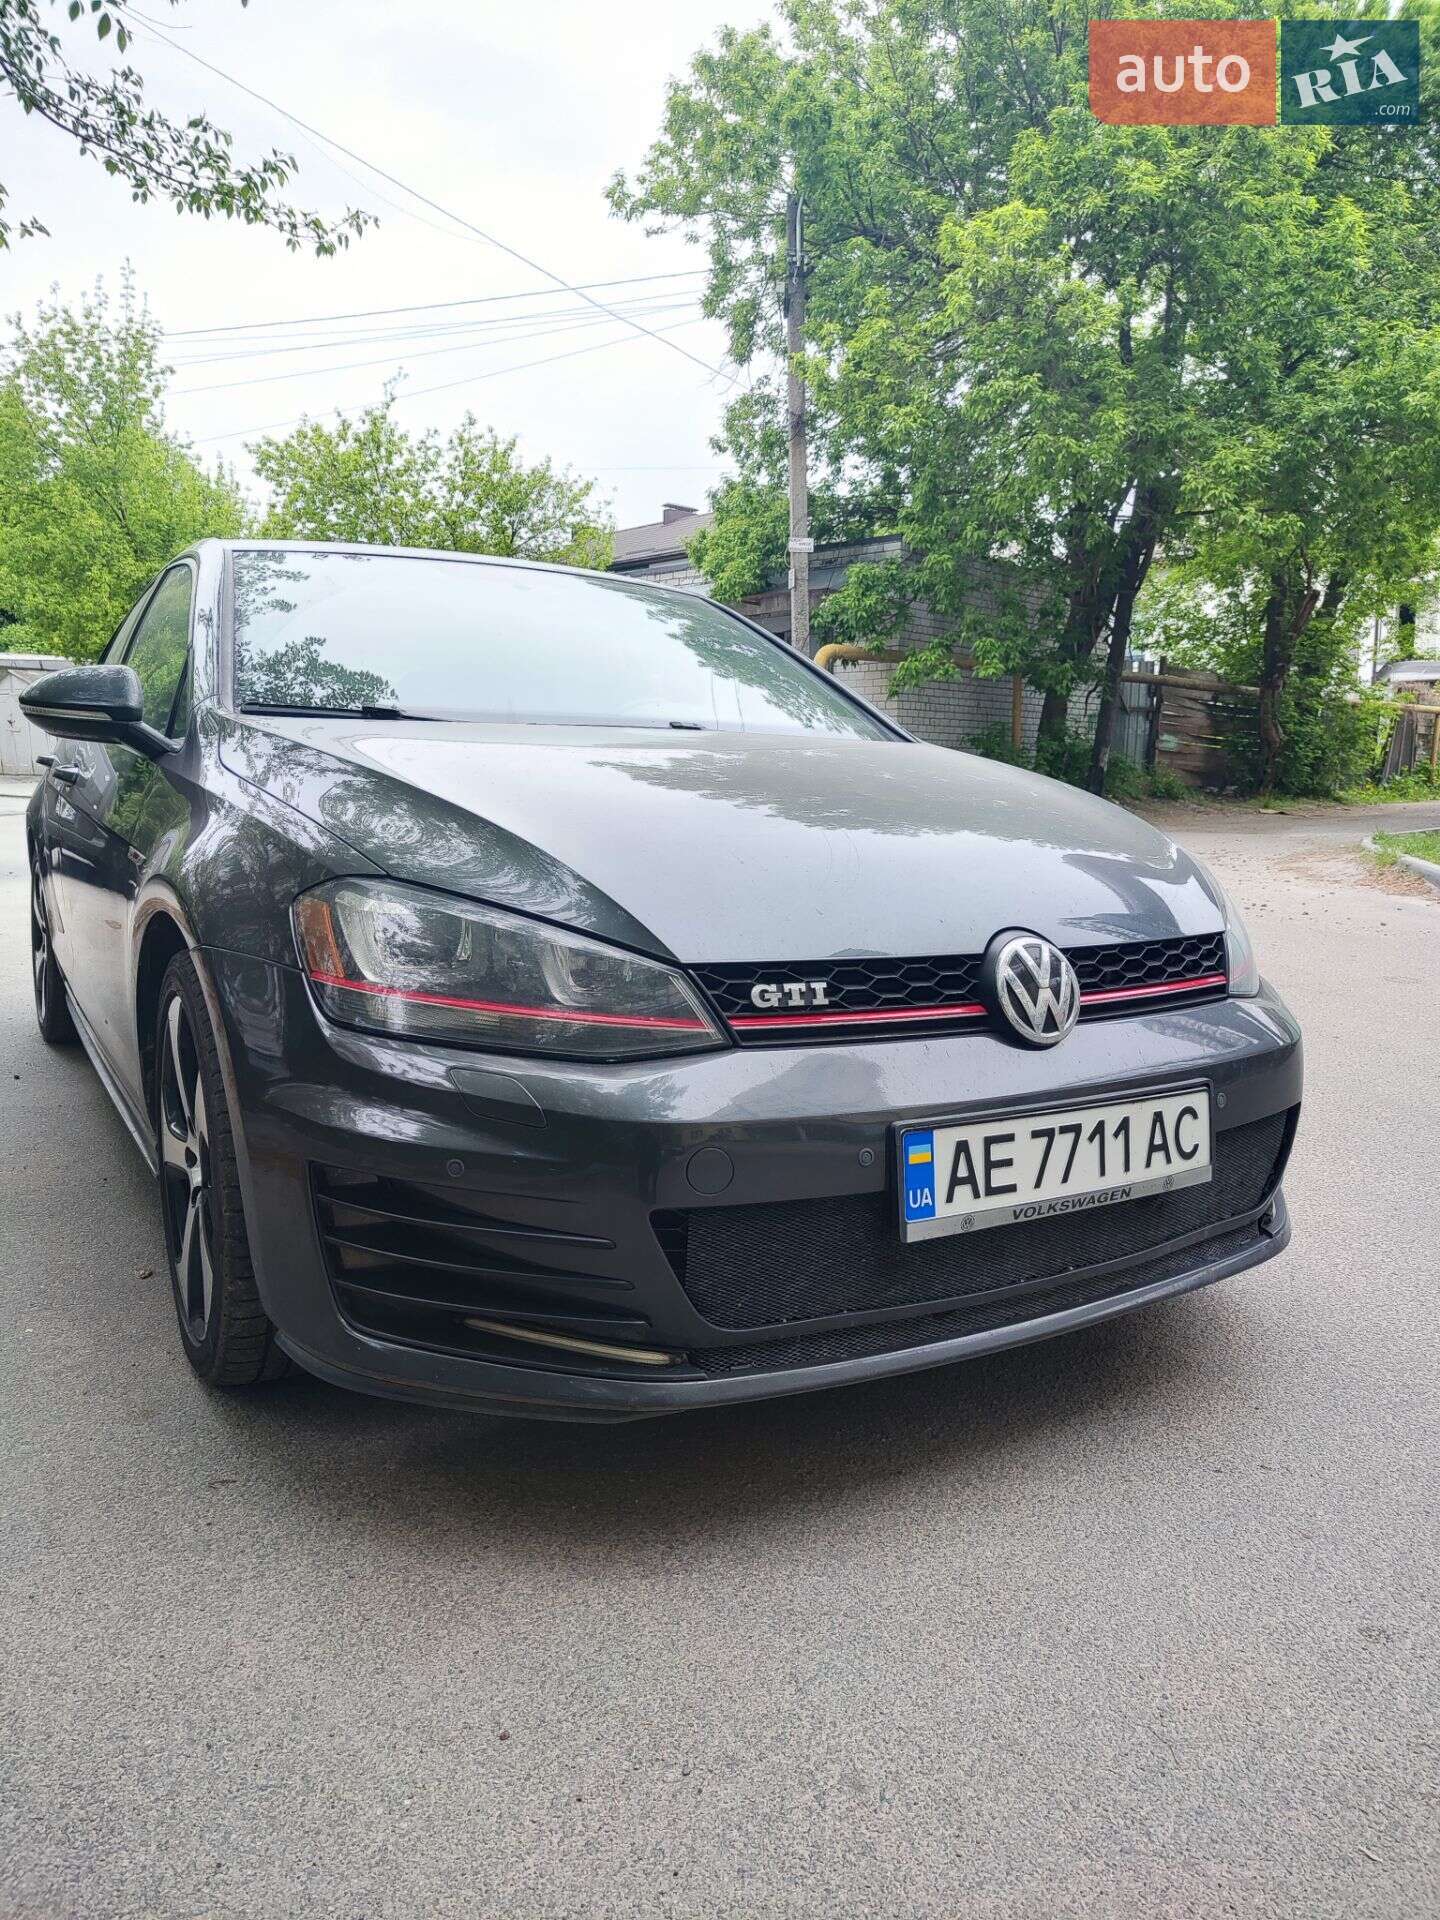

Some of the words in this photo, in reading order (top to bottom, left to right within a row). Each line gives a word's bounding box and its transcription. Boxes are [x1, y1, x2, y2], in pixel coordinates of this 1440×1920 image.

[750, 982, 829, 1008] GTI
[945, 1132, 1017, 1204] AE
[1030, 1115, 1131, 1190] 7711
[1145, 1105, 1200, 1169] AC
[909, 1187, 933, 1209] UA
[1012, 1187, 1132, 1220] VOLKSWAGEN
